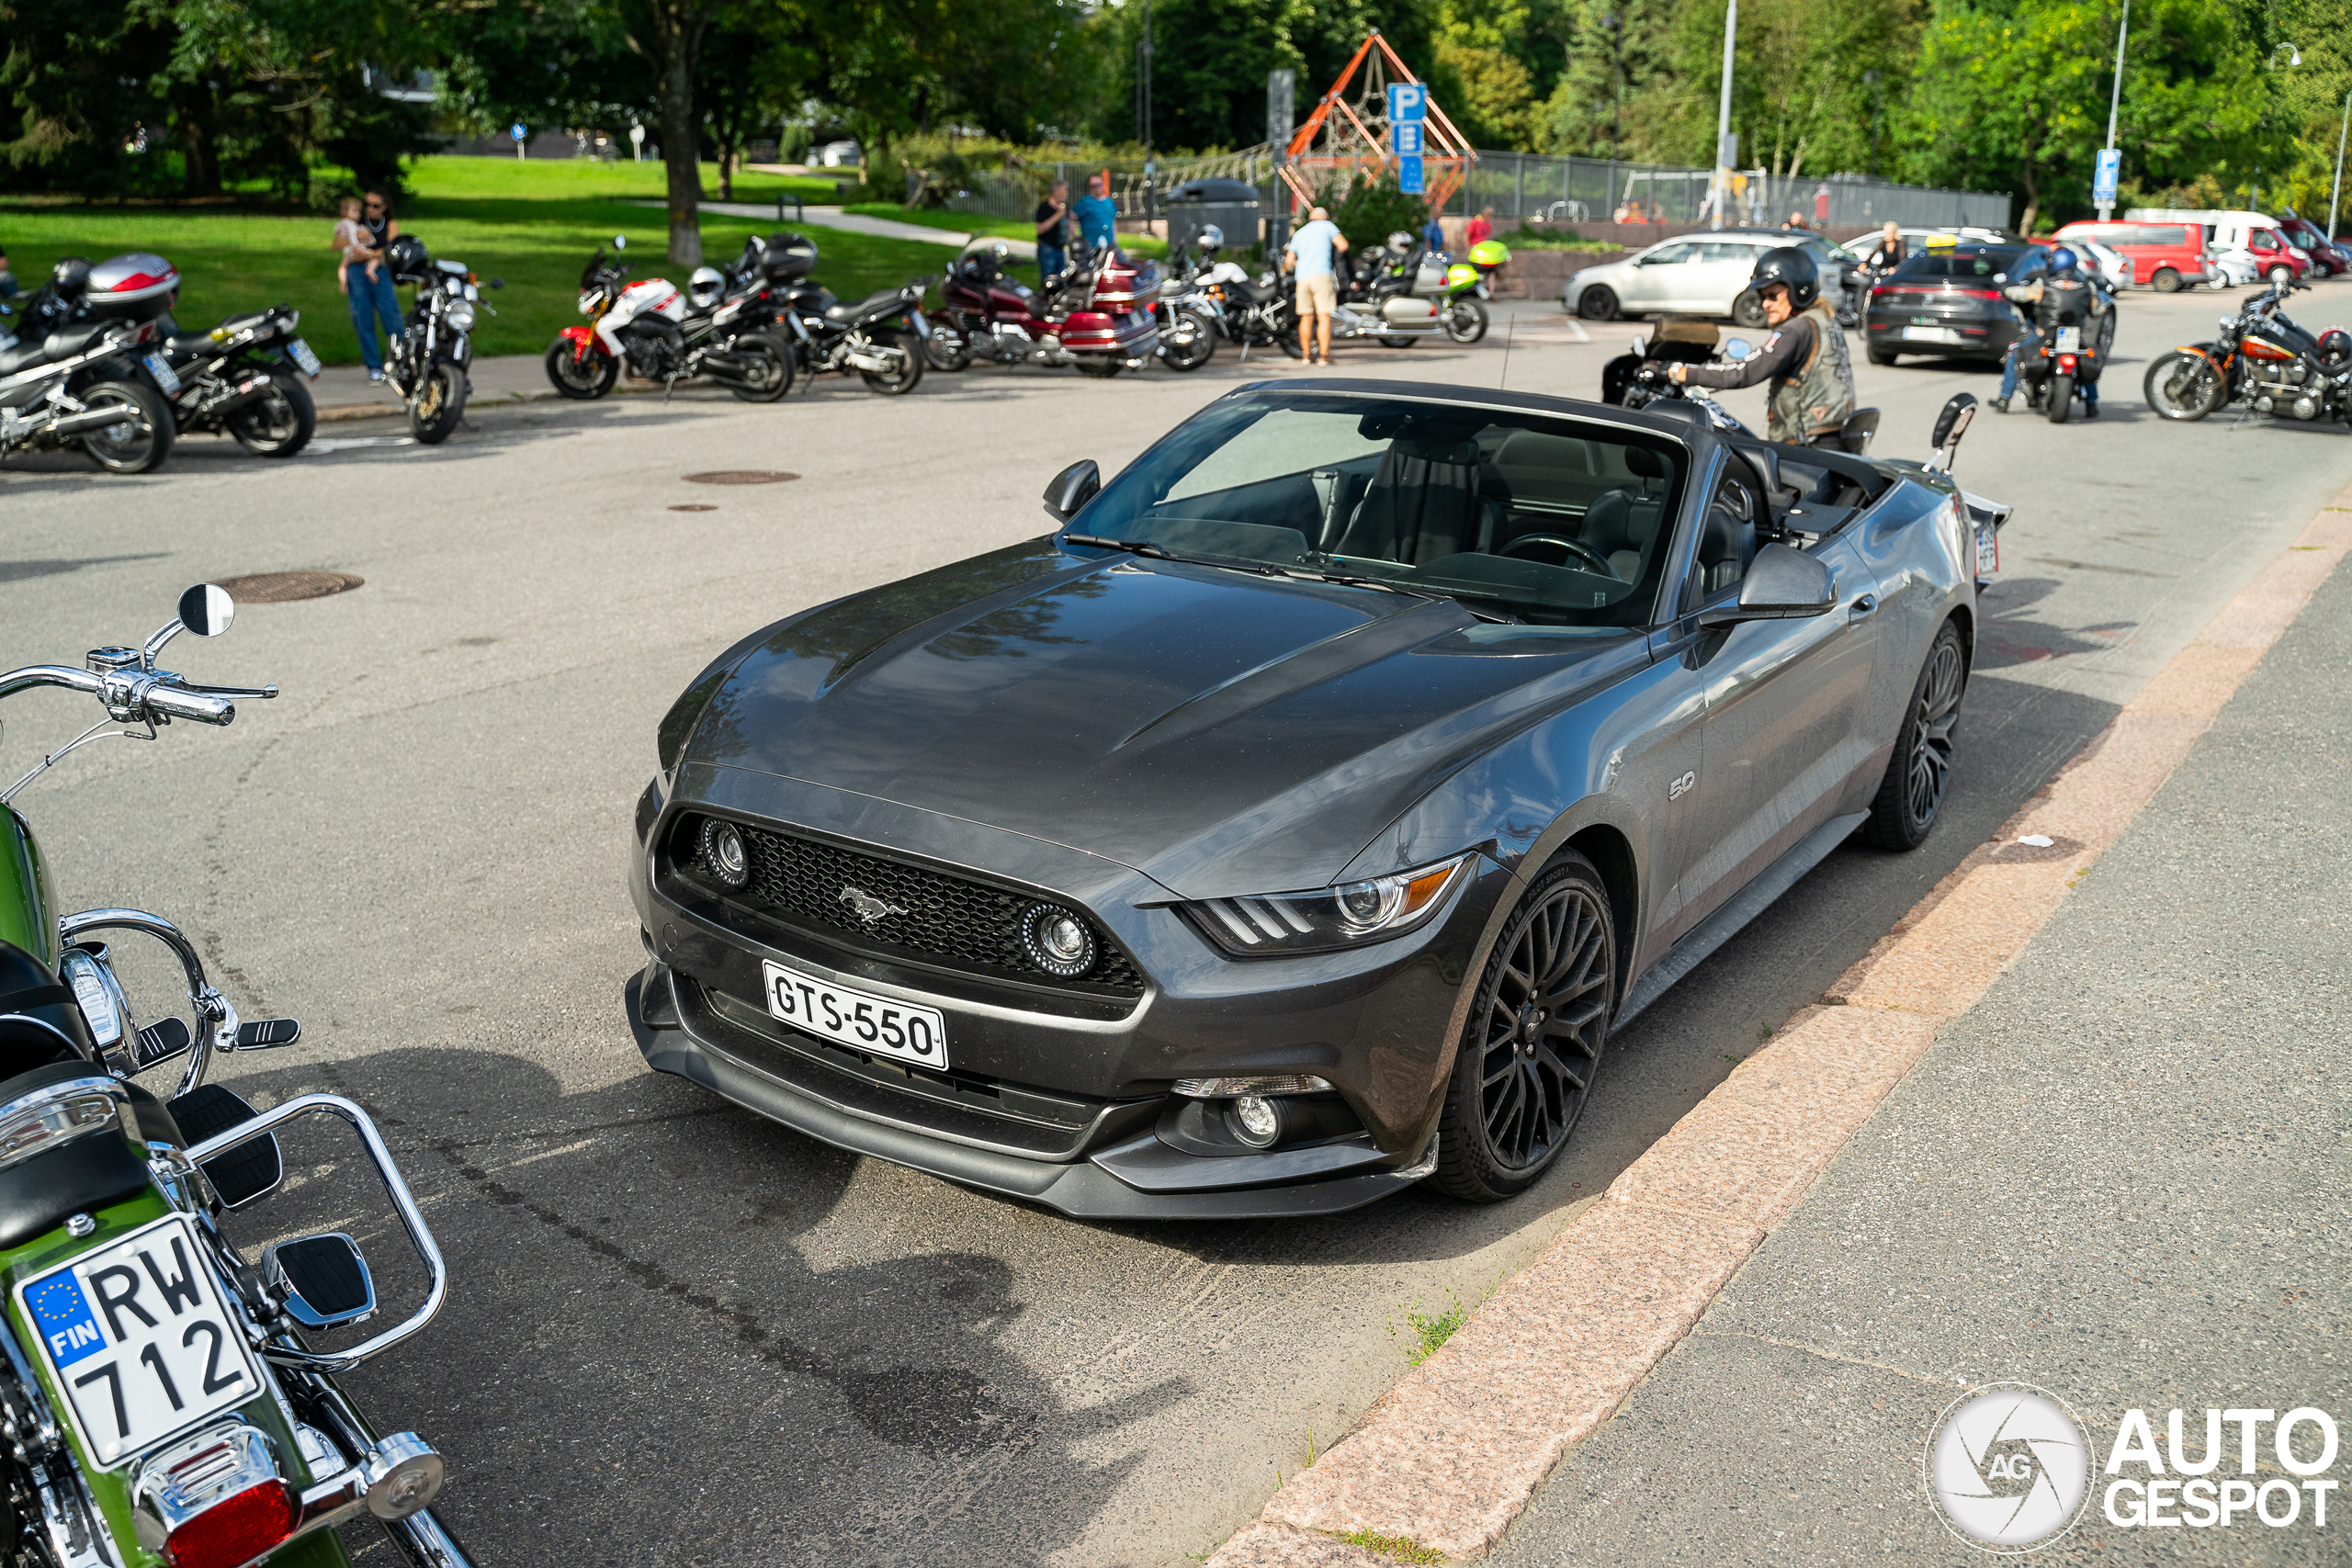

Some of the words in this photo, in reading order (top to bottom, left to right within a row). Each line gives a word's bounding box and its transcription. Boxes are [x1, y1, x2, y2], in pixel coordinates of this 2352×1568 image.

[1395, 87, 1420, 119] P
[1527, 879, 1545, 903] PILOT
[1545, 867, 1566, 884] SPORT
[1476, 904, 1524, 1014] MICHELIN
[775, 976, 933, 1055] GTS-550
[88, 1235, 202, 1343] RW
[49, 1319, 99, 1358] FIN
[74, 1319, 243, 1438] 712
